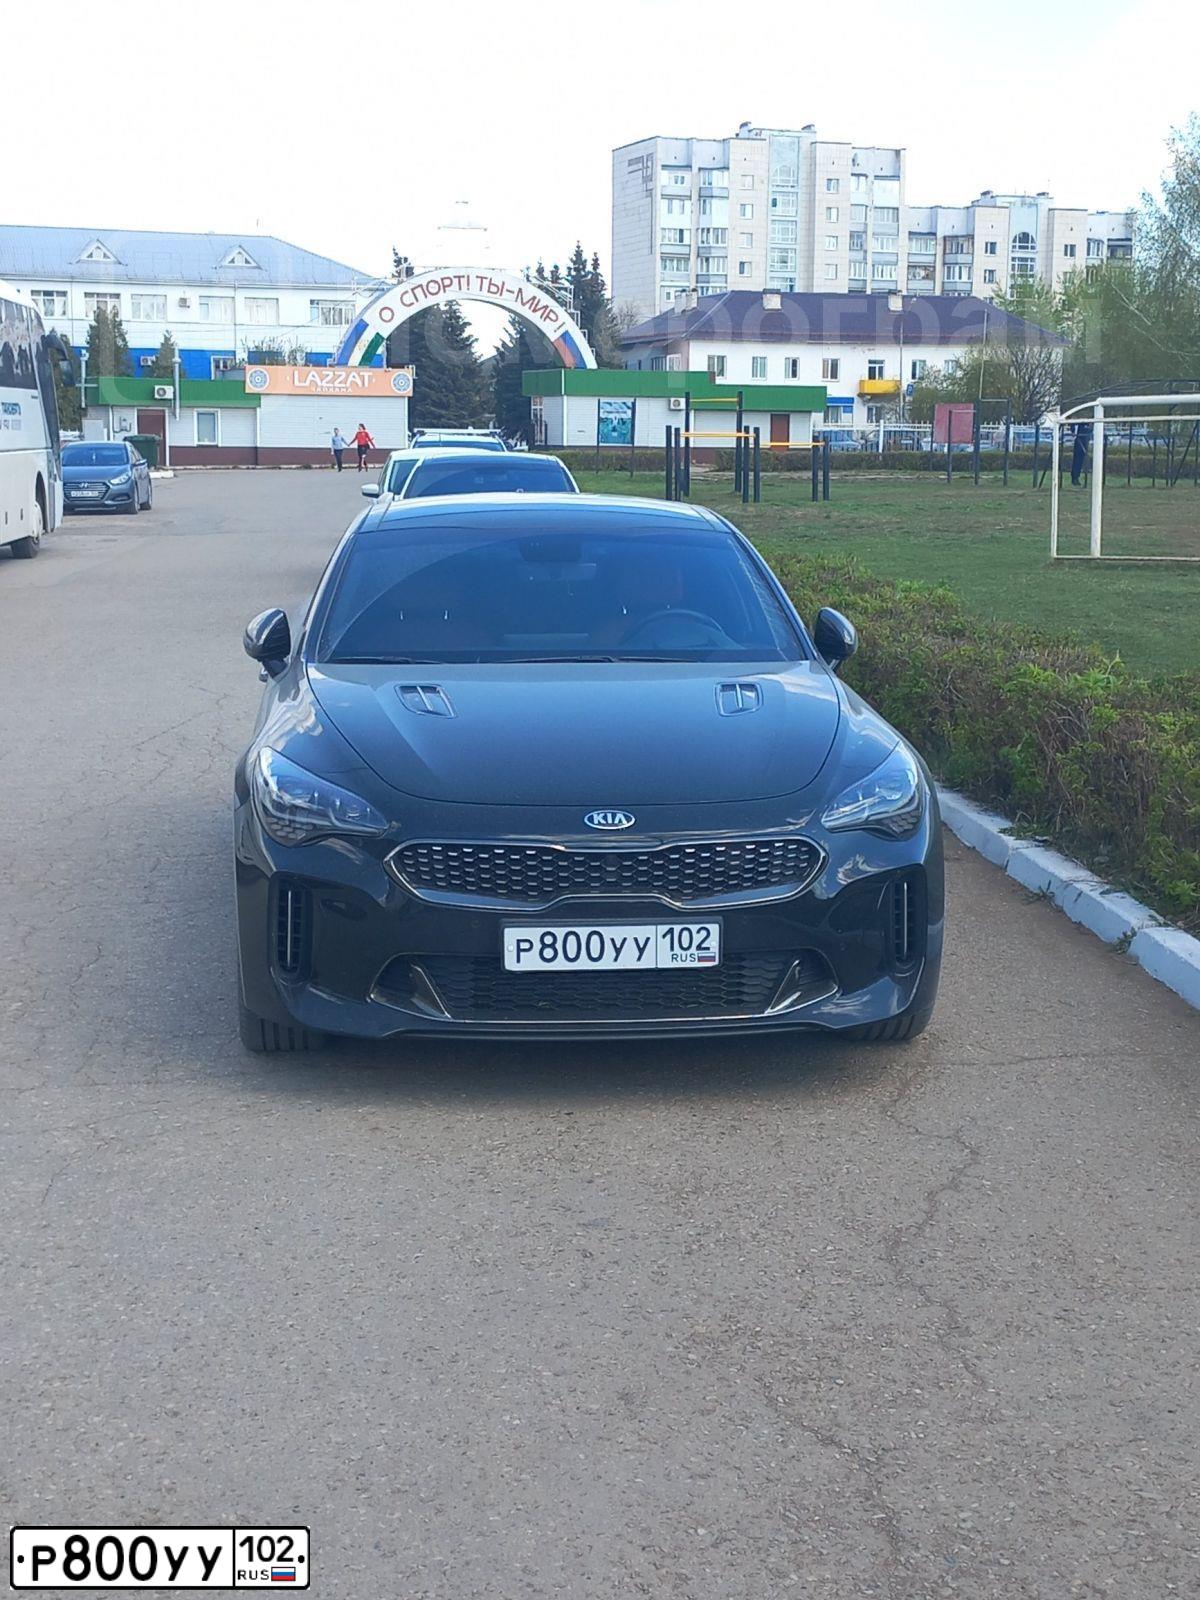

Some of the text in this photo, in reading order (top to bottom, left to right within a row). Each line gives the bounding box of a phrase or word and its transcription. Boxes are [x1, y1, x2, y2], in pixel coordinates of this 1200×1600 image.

[399, 274, 472, 307] СПОРТ!
[293, 370, 373, 388] LAZZAT
[592, 812, 628, 826] KIA
[661, 926, 712, 952] 102
[670, 953, 697, 963] RUS
